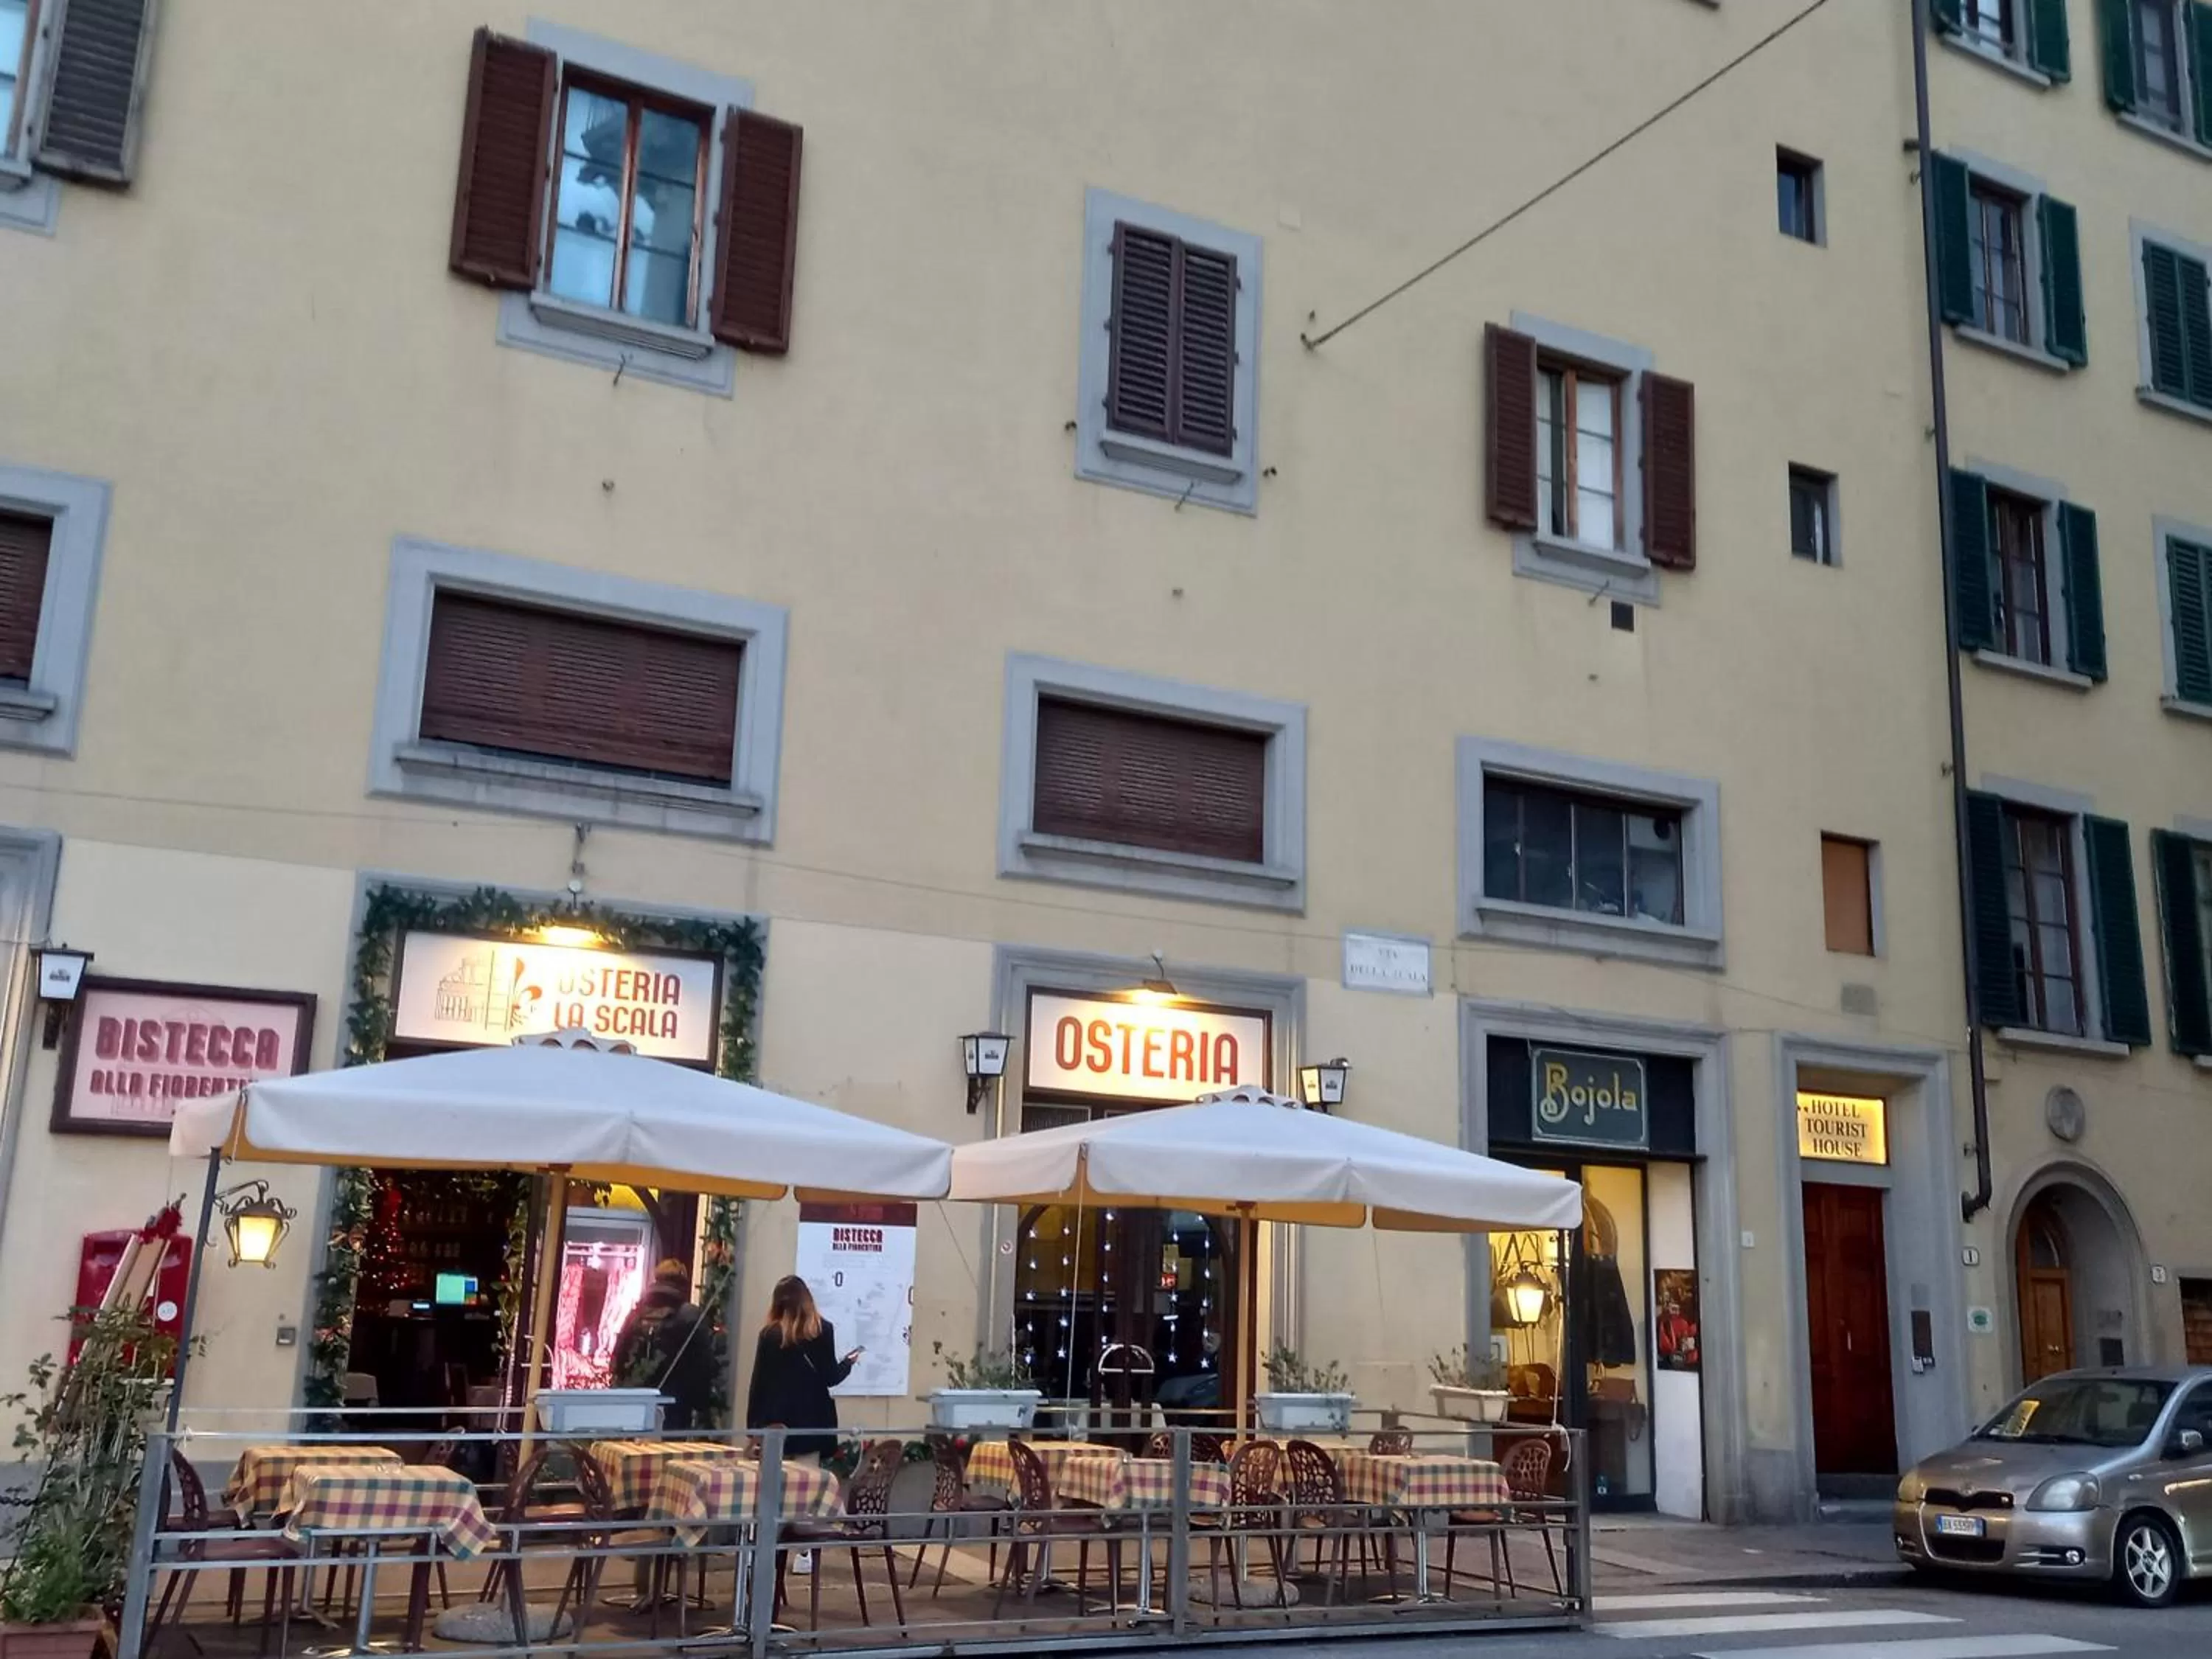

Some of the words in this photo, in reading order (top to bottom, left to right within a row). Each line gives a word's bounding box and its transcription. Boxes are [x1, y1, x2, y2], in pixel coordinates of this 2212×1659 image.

[558, 967, 681, 1006] OSTERIA
[554, 1002, 584, 1029] LA
[594, 1005, 677, 1038] SCALA
[96, 1015, 279, 1070] BISTECCA
[1055, 1015, 1239, 1085] OSTERIA
[90, 1070, 143, 1096] ALLA
[149, 1073, 259, 1097] FIORENT
[1540, 1062, 1638, 1125] Bojola
[1812, 1099, 1860, 1118] HOTEL
[1806, 1118, 1867, 1138] TOURIST
[1813, 1138, 1863, 1158] HOUSE
[833, 1228, 883, 1243] BISTECCA
